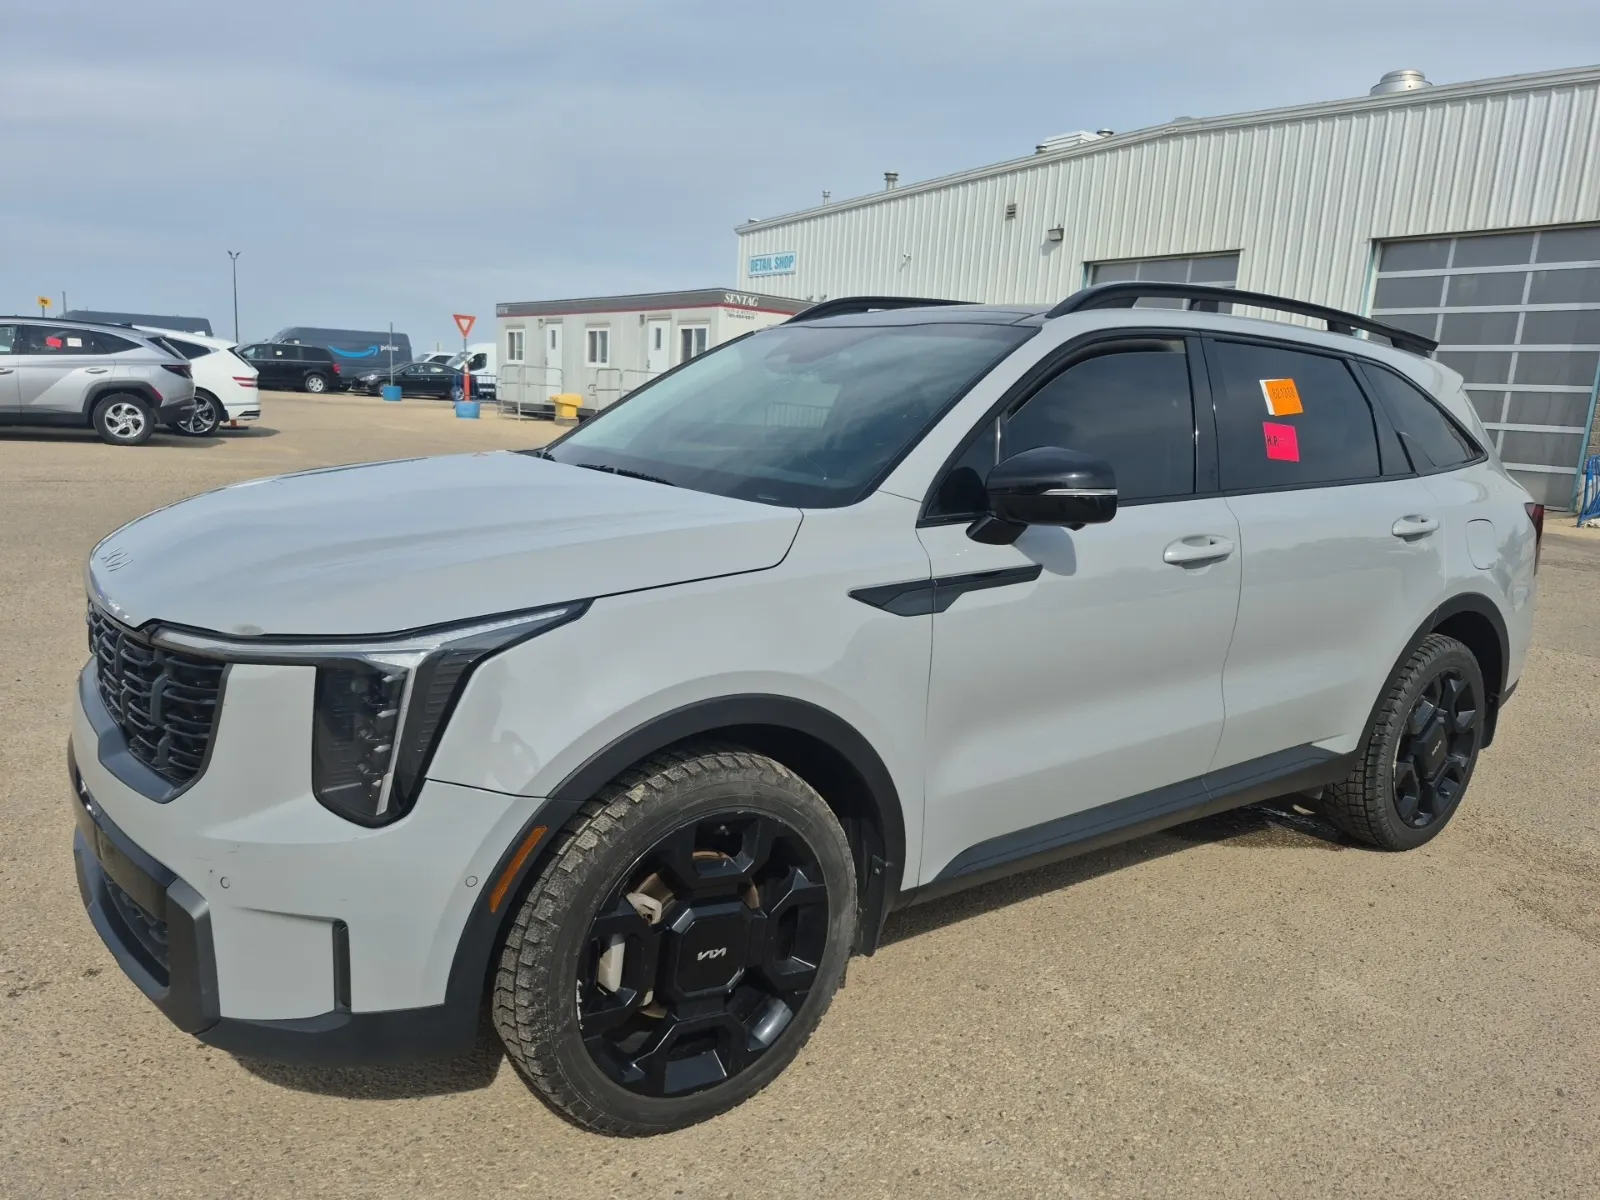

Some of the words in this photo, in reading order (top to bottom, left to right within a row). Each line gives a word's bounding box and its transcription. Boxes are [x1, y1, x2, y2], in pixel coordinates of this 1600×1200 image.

[751, 257, 772, 272] DETAIL
[774, 255, 794, 270] SHOP
[724, 292, 759, 307] SENTAG
